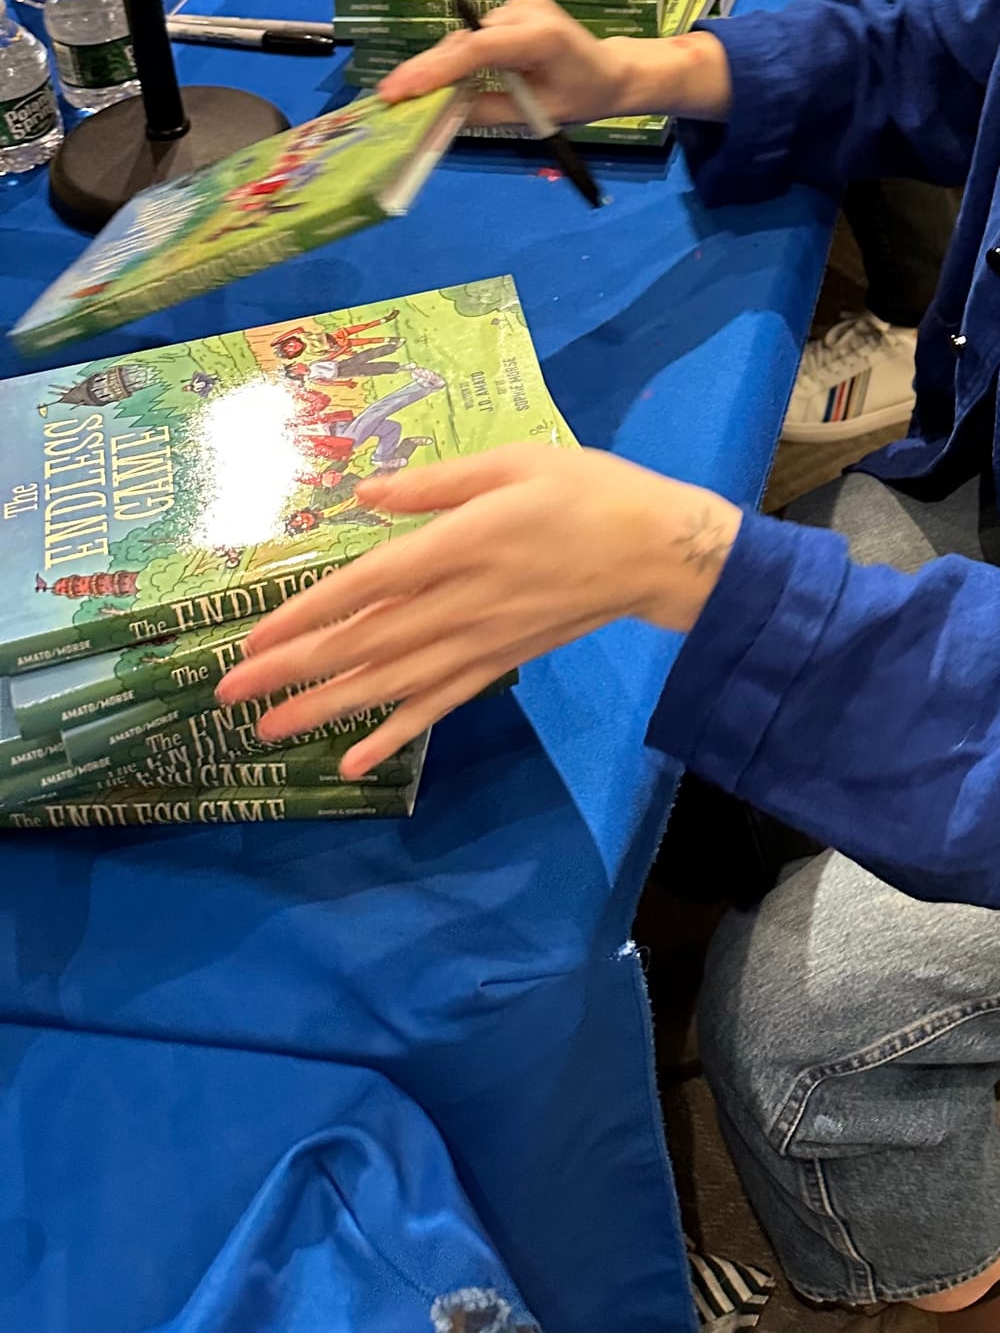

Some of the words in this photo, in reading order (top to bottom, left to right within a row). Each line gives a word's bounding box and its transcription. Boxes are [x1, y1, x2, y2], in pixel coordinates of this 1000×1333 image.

[470, 371, 490, 397] AMATO
[503, 356, 522, 384] MORSE
[509, 384, 530, 412] SOPHIE
[111, 425, 175, 521] GAME
[3, 483, 38, 519] The
[44, 414, 109, 570] ENDLESS
[17, 639, 92, 666] AMATO/MORSE
[129, 619, 167, 640] The
[61, 690, 136, 721] AMATO/MORSE
[171, 664, 210, 689] The
[109, 711, 179, 745] AMATO/MORSE
[145, 732, 183, 753] The
[40, 756, 111, 787] AMATO/MORSE
[199, 798, 286, 823] GAME
